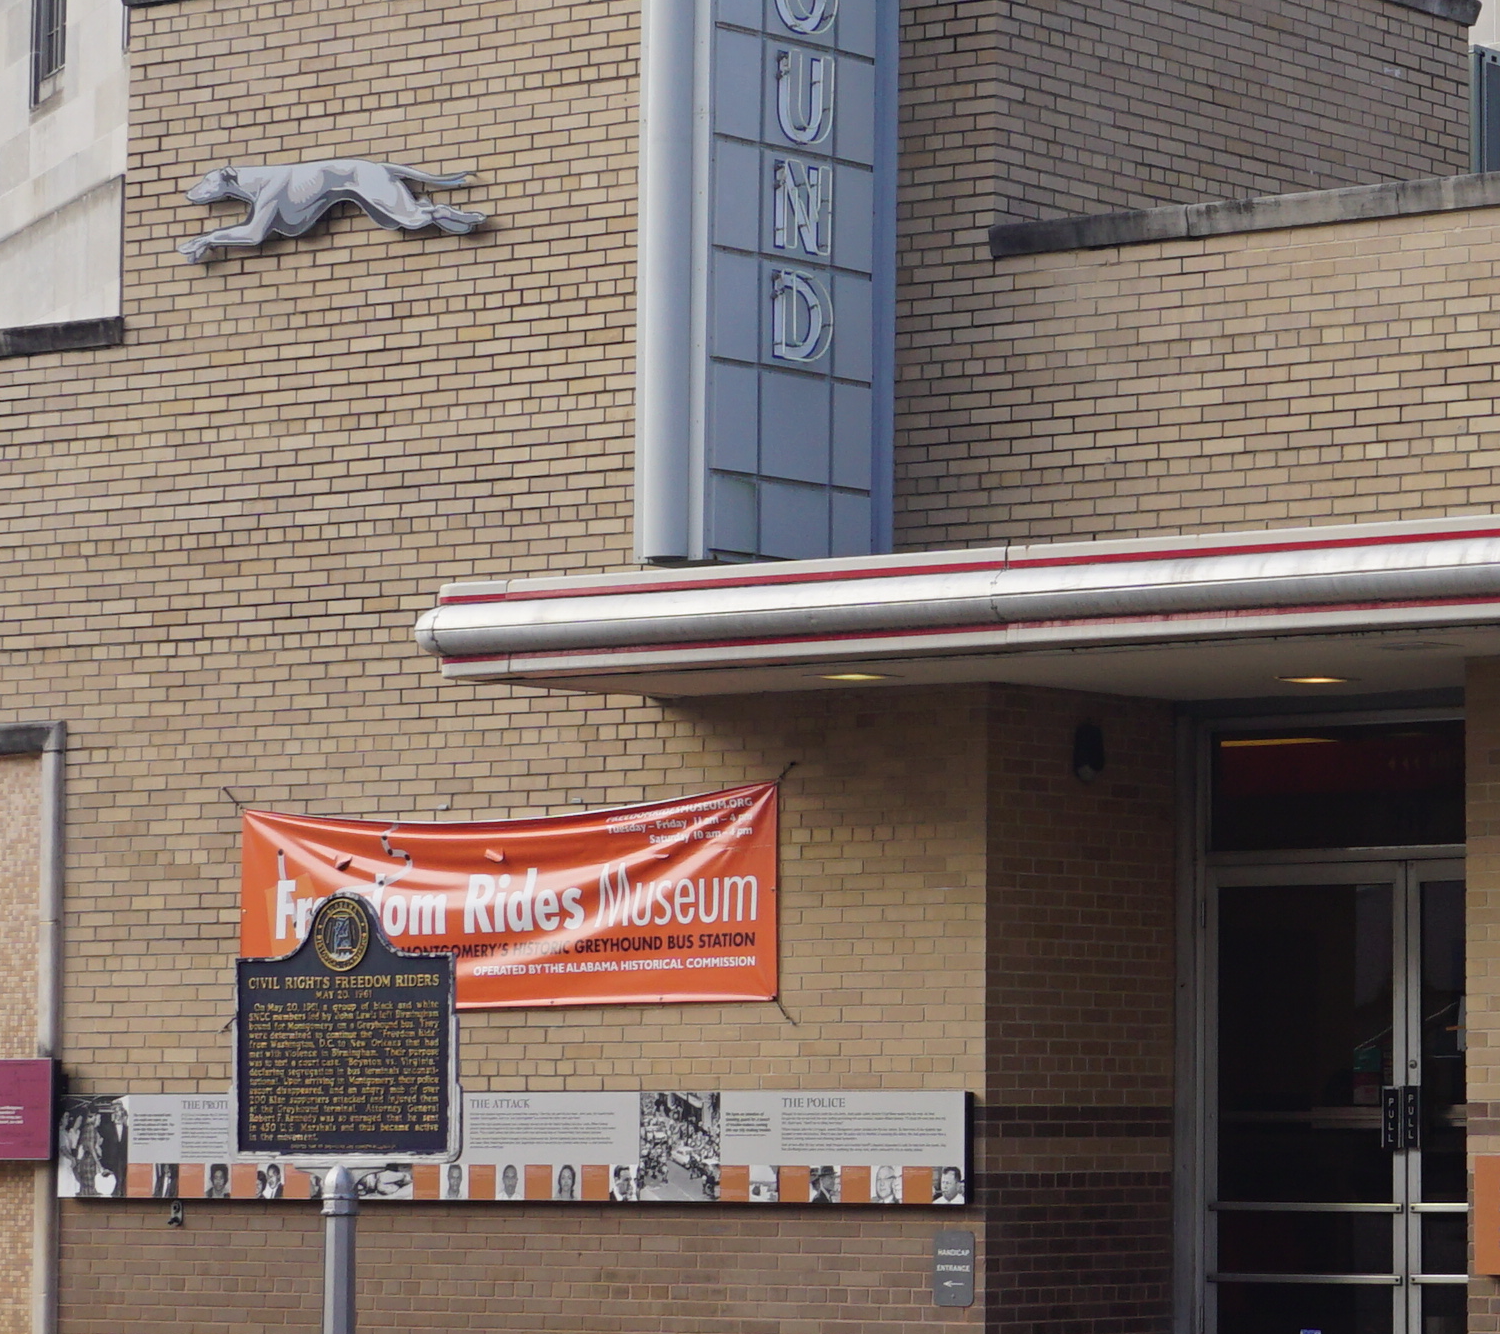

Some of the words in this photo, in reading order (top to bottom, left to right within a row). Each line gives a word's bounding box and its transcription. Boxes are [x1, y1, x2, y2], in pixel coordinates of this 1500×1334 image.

[607, 822, 646, 835] Tuesday
[656, 818, 687, 830] Friday
[693, 817, 701, 826] 11
[704, 817, 719, 825] am
[729, 813, 736, 821] 4
[739, 813, 753, 824] pm
[649, 832, 689, 845] Saturday
[693, 831, 702, 840] 10
[705, 830, 721, 838] am
[737, 826, 752, 838] pm
[463, 868, 583, 933] Rides
[594, 861, 758, 928] Museum
[512, 940, 570, 955] HISTORIC
[574, 936, 662, 954] GREYHOUND
[667, 935, 693, 950] BUS
[698, 932, 756, 948] STATION
[473, 963, 526, 976] OPERATED
[528, 963, 541, 975] BY
[544, 962, 565, 974] THE
[566, 960, 618, 973] ALABAMA
[620, 957, 683, 970] HISTORICAL
[686, 955, 755, 968] COMMISSION
[248, 977, 280, 990] CIVIL
[285, 976, 331, 990] RIGHTS
[335, 975, 391, 989] FREEDOM
[395, 974, 440, 987] RIDERS
[315, 991, 334, 1000] MAY
[355, 990, 373, 999] 1961
[181, 1100, 200, 1110] THE
[470, 1098, 490, 1109] THE
[492, 1098, 530, 1109] ATTACK
[781, 1097, 804, 1108] THE
[806, 1097, 846, 1108] POLICE
[1387, 1097, 1395, 1143] PULL
[1407, 1093, 1415, 1140] PULL
[937, 1248, 970, 1257] HANDICAP
[936, 1264, 970, 1273] ENTRANCE
